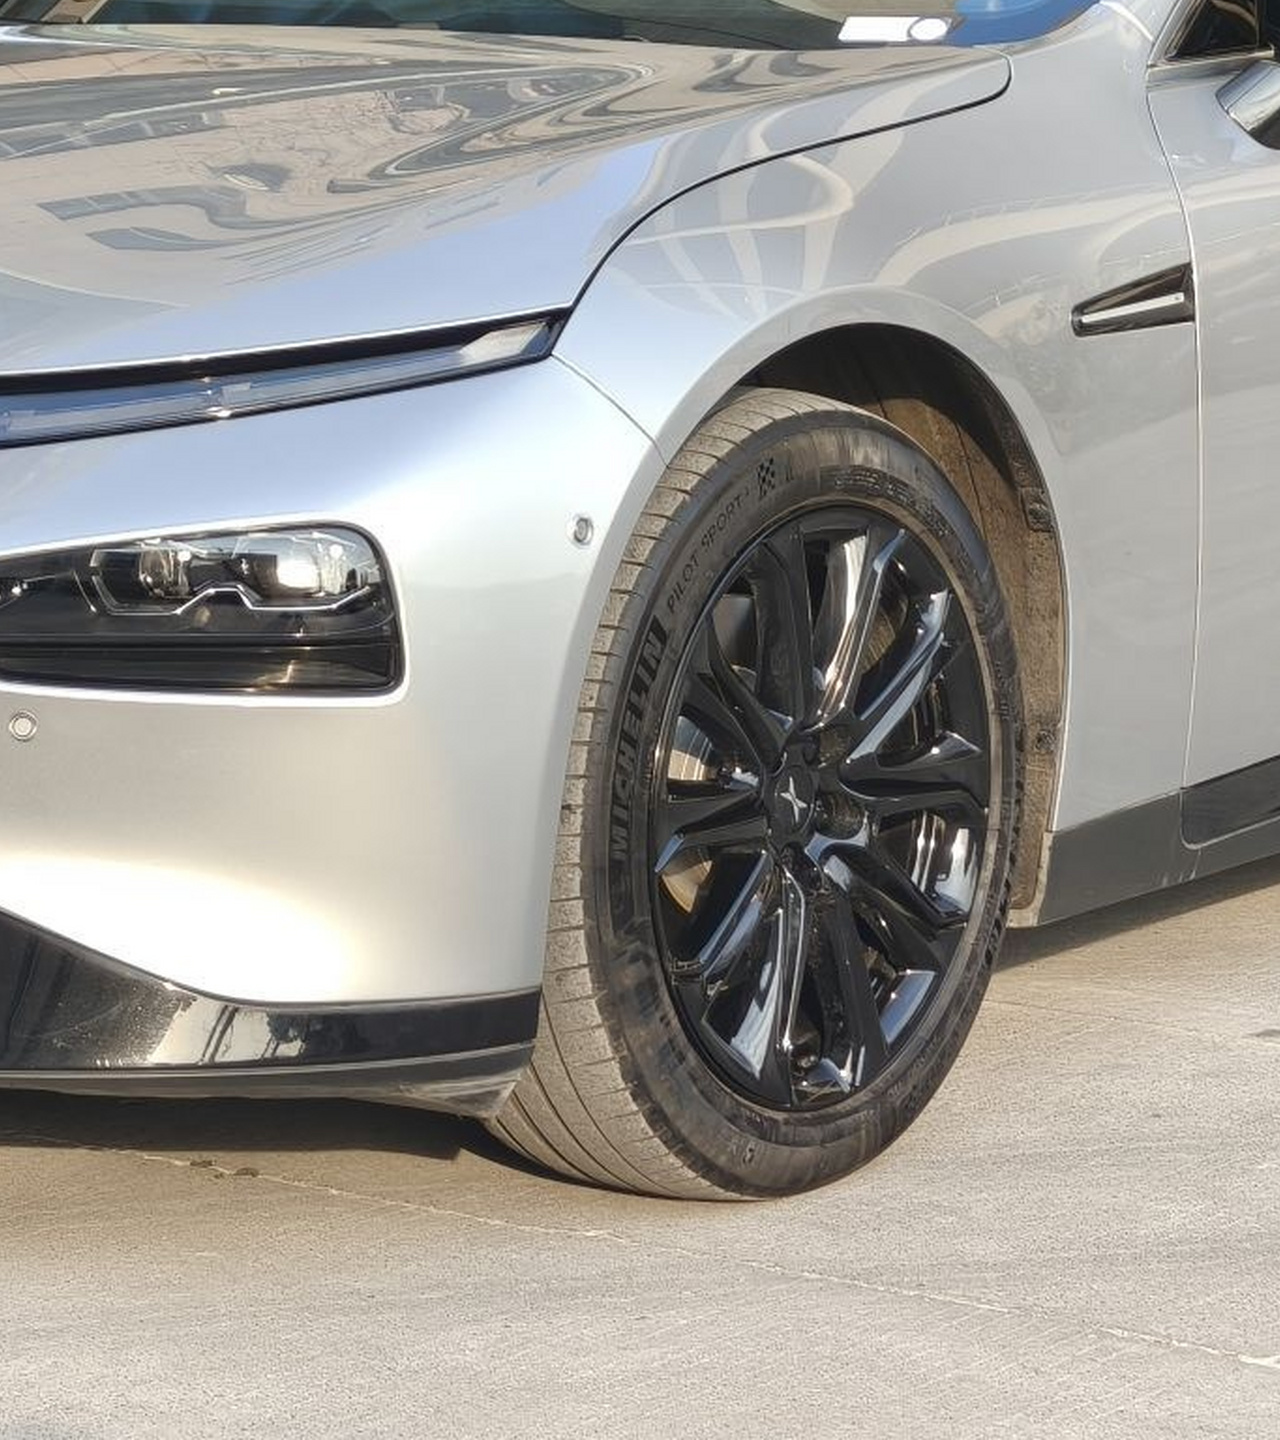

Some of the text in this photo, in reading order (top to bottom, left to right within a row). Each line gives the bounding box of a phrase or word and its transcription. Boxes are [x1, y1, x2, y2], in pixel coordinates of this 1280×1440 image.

[667, 494, 742, 613] PILOT SPORT
[610, 613, 668, 863] MICHELIN
